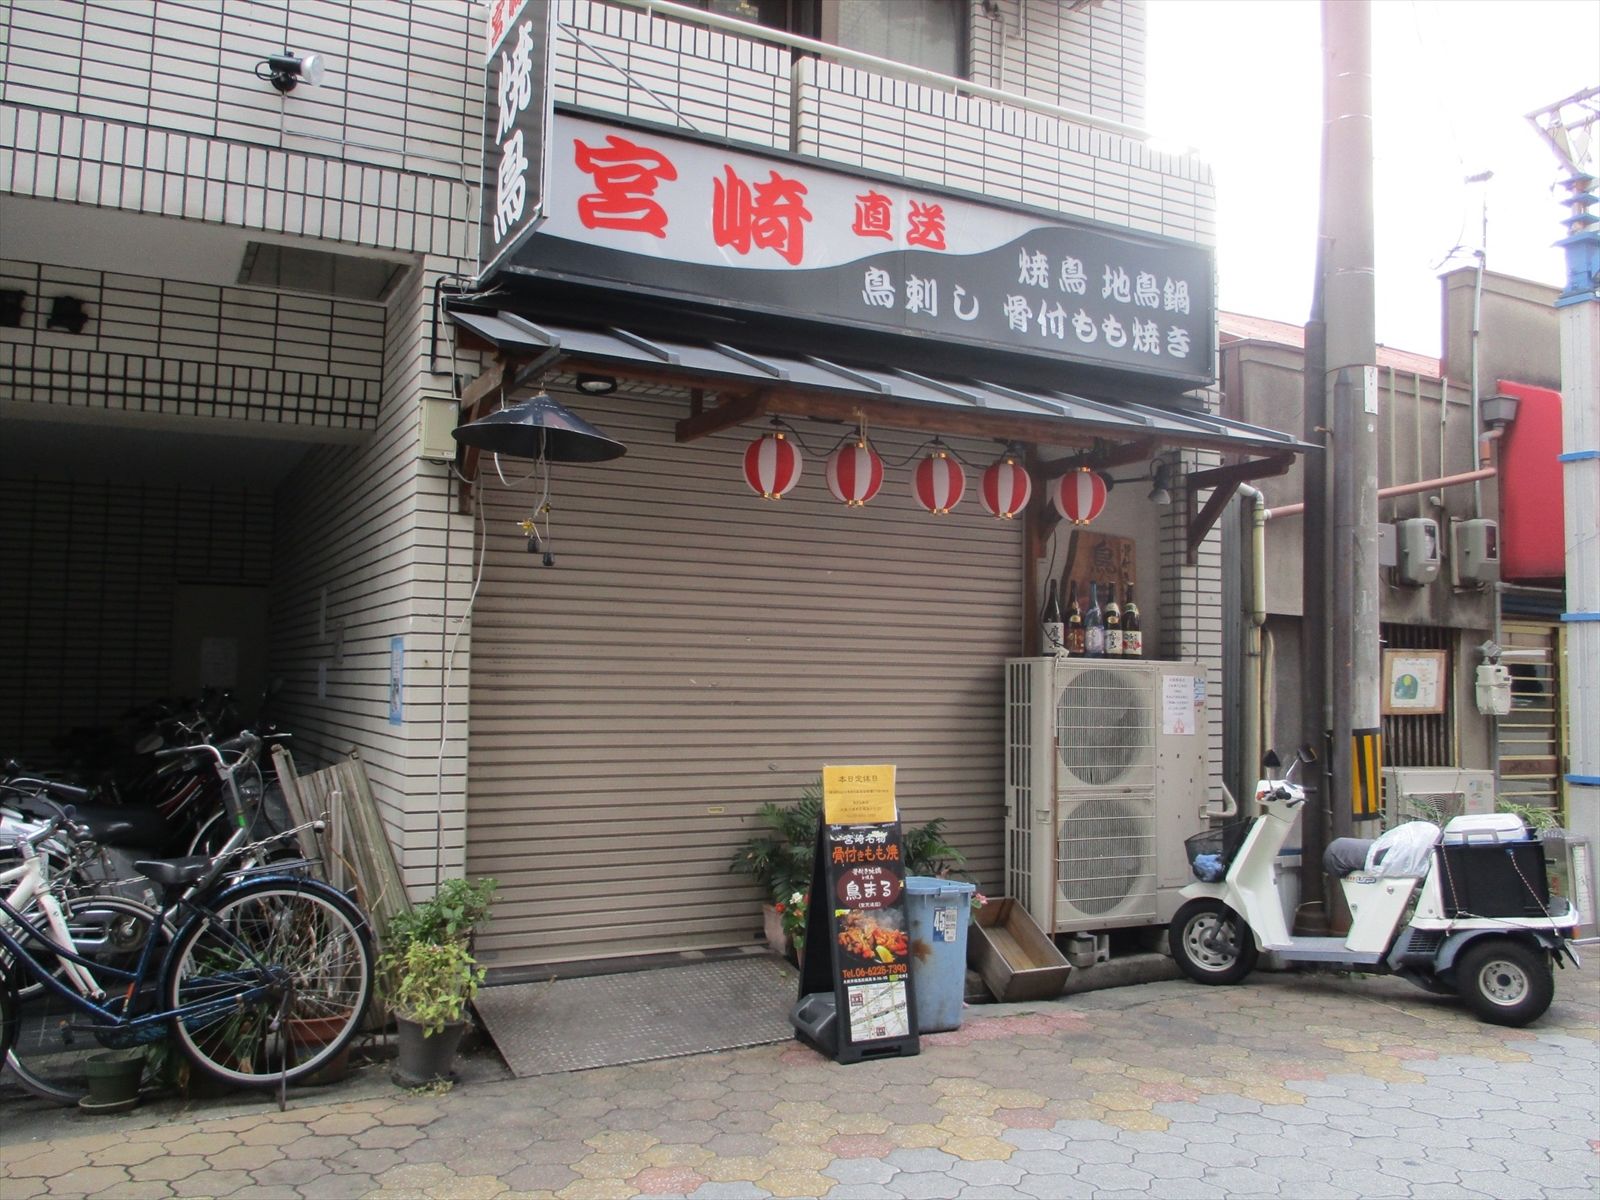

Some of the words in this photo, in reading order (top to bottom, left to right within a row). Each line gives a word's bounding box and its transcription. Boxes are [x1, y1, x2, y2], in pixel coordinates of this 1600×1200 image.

[493, 20, 533, 243] 焼鳥
[574, 135, 813, 267] 宮崎
[851, 189, 947, 251] 直送
[862, 266, 980, 321] 鳥刺し
[1018, 247, 1088, 295] 焼鳥
[1102, 265, 1190, 315] 地鳥鍋
[1003, 294, 1191, 359] 骨付もも焼き
[832, 844, 899, 864] 骨付きもも焼
[846, 880, 892, 901] 鳥まる
